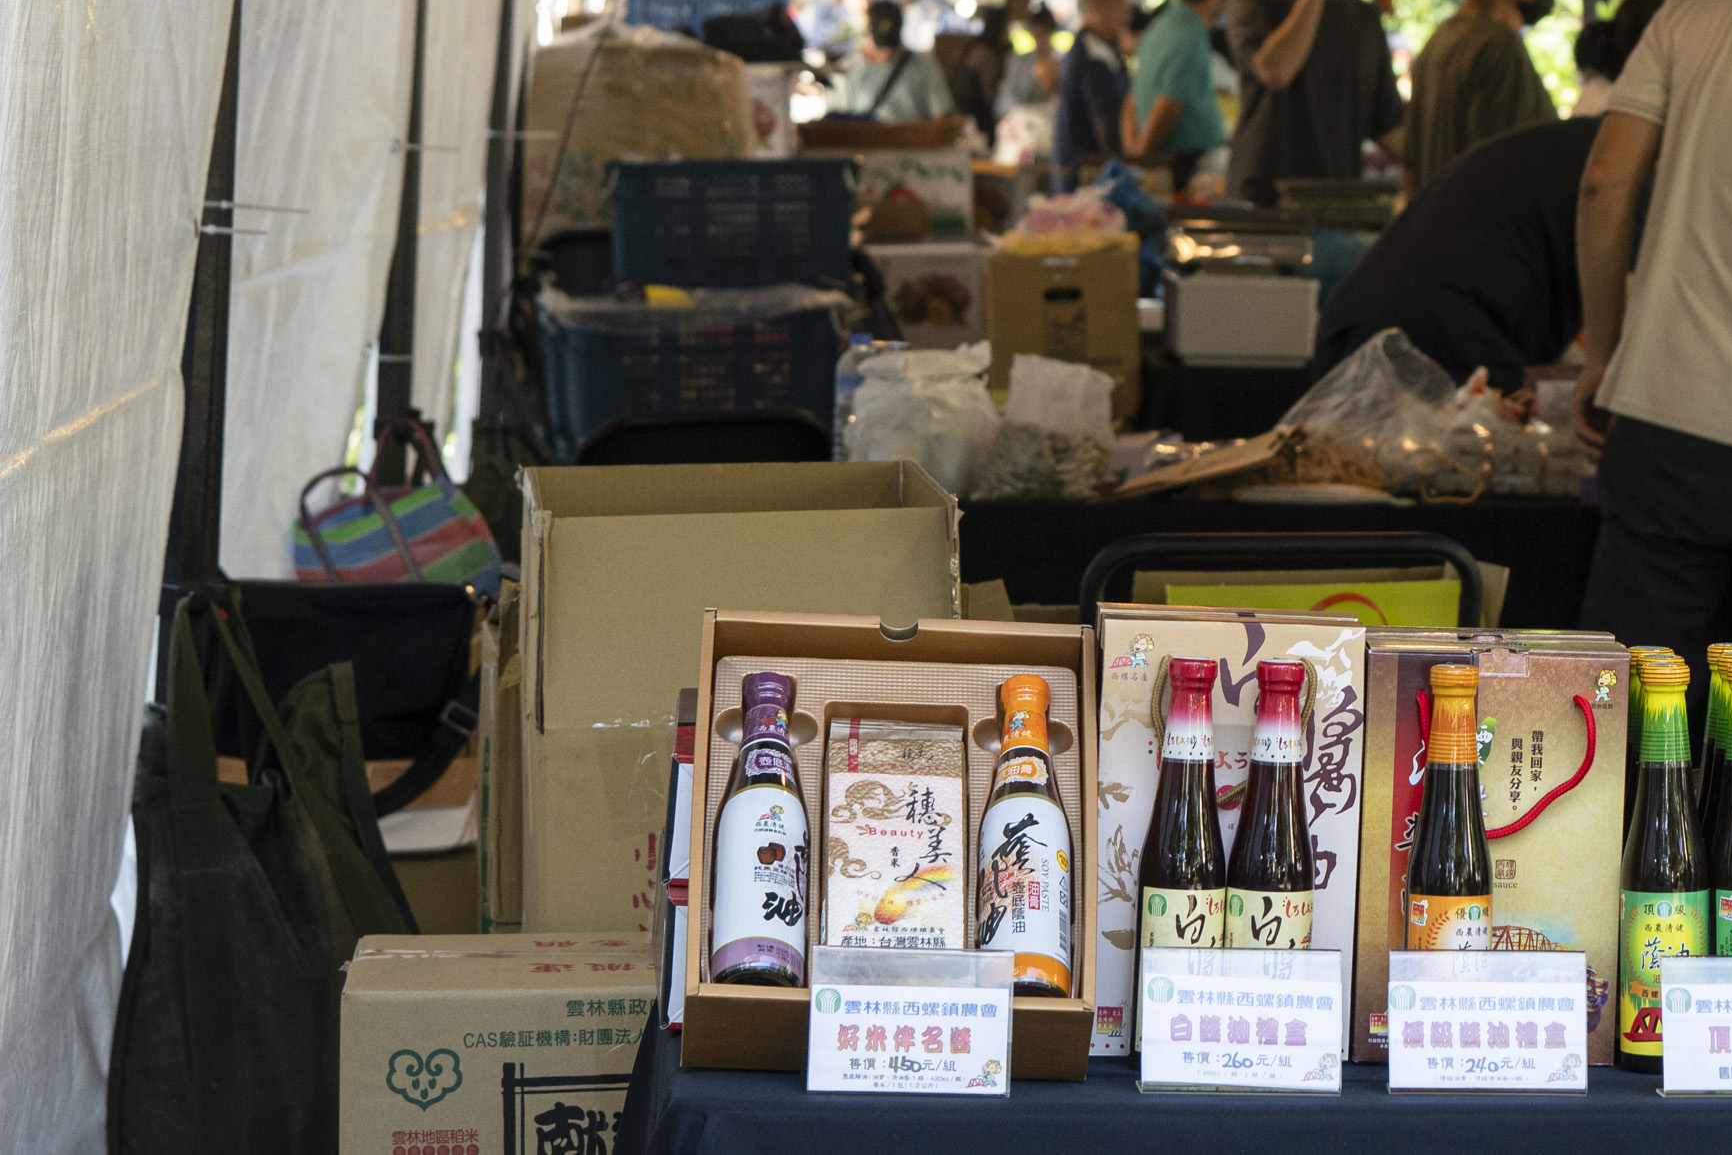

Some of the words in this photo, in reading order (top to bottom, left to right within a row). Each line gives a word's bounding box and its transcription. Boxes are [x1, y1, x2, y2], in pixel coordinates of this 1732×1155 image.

[1111, 672, 1149, 683] 西螺名產
[868, 827, 924, 839] Beauty
[890, 846, 901, 868] 香米
[1041, 858, 1050, 881] SOY
[1644, 923, 1684, 933] 西農清健
[844, 1000, 998, 1018] 雲林縣西螺鎮農會
[1177, 989, 1334, 1011] 雲林縣西螺鎮農會
[1419, 996, 1575, 1012] 雲林縣西螺鎮農會
[1170, 1014, 1308, 1046] 白醬油禮盒
[1402, 1021, 1567, 1049] 優級醬油禮盒
[391, 1128, 480, 1145] 雲林地區稻米
